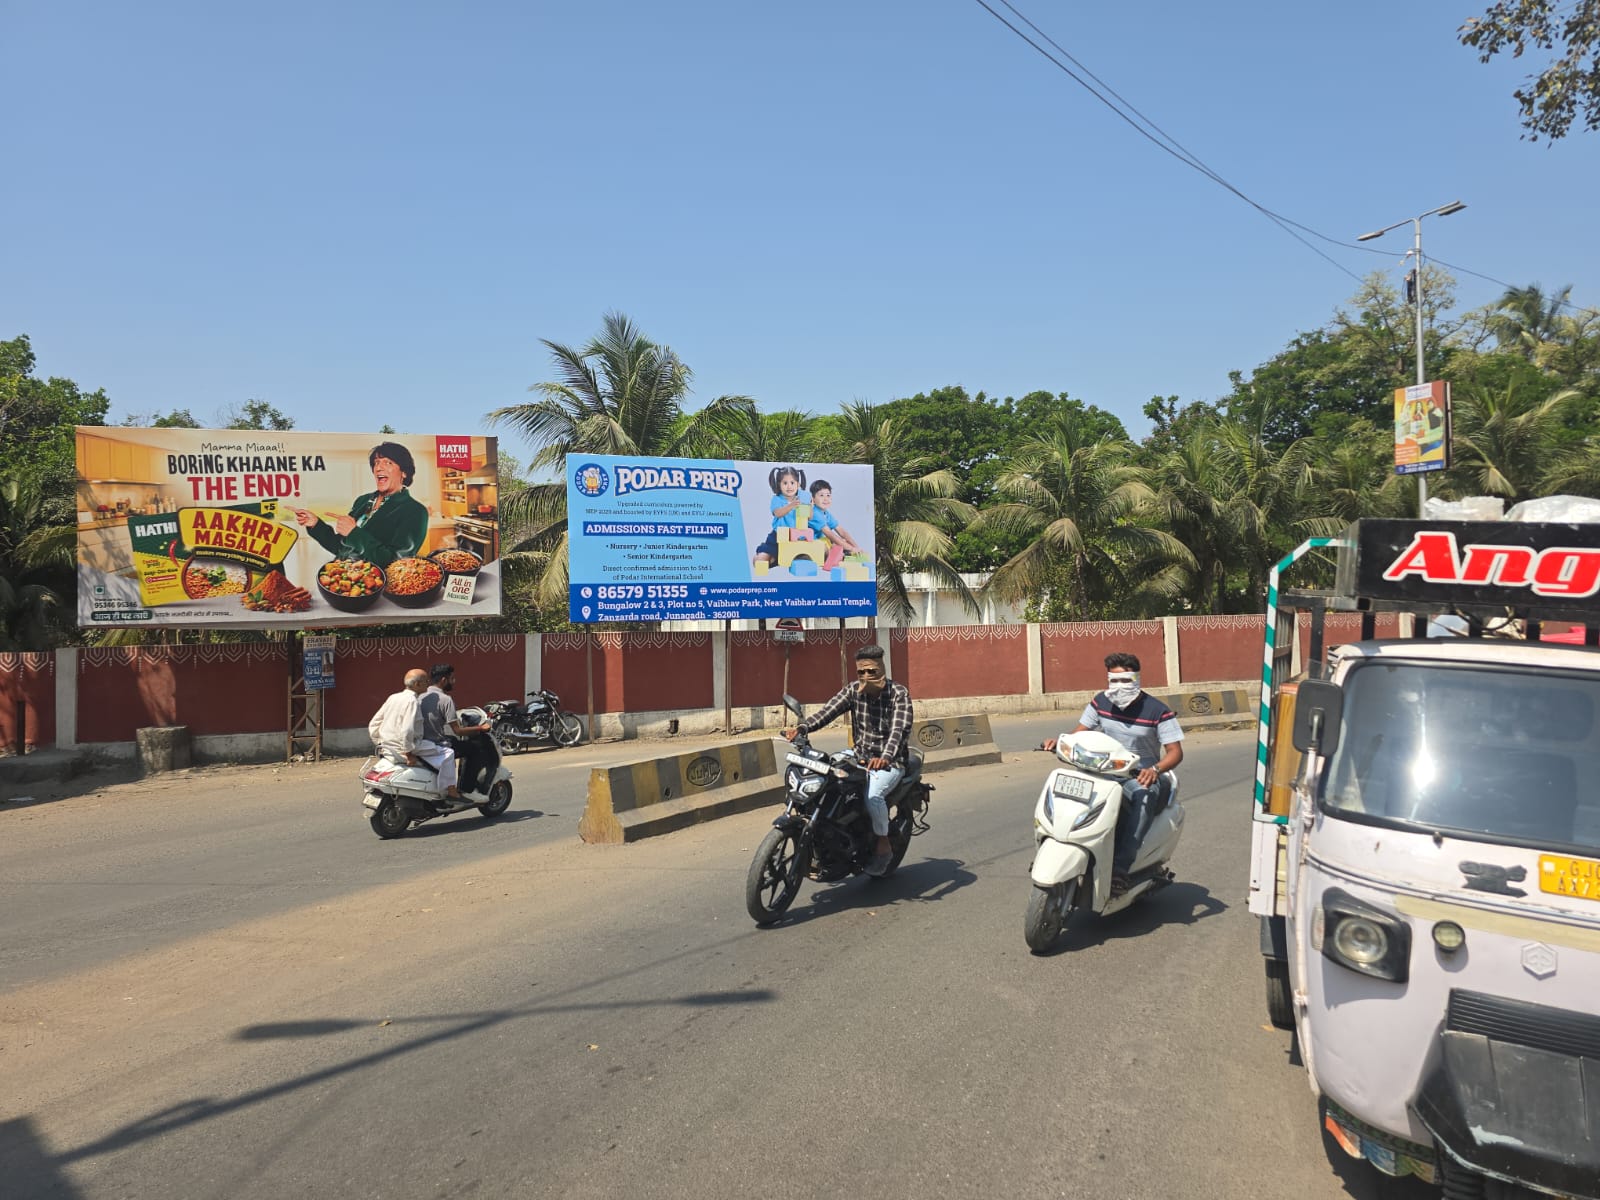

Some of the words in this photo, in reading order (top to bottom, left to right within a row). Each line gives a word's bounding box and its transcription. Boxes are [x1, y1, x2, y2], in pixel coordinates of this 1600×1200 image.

[201, 443, 242, 453] Mamma
[440, 444, 468, 453] HATHI
[227, 456, 297, 472] KHAANE
[302, 455, 326, 471] KA
[187, 476, 238, 501] THE
[244, 474, 300, 497] END!
[618, 468, 686, 494] PODAR
[689, 470, 740, 495] PREP
[135, 521, 177, 537] HATHI
[192, 510, 283, 544] AAKHRI
[586, 524, 656, 534] ADMISSIONS
[656, 524, 683, 534] FAST
[684, 525, 724, 535] FILLING
[194, 529, 272, 559] MASALA
[610, 543, 638, 551] Nursery
[451, 578, 462, 586] All
[464, 579, 472, 587] in
[452, 586, 470, 594] one
[598, 586, 644, 599] 86579
[648, 585, 688, 598] 51355
[710, 586, 778, 595] www.podarprep.com
[598, 601, 641, 611] Bungalow
[644, 601, 649, 609] 2
[650, 600, 657, 608] &
[658, 600, 666, 610] 3,
[667, 600, 684, 608] Plot
[698, 600, 705, 609] 5,
[707, 599, 740, 608] Vaibhav
[742, 599, 763, 608] Park,
[764, 599, 783, 607] Near
[784, 598, 816, 607] Vaibhav
[818, 598, 842, 606] Laxmi
[843, 597, 872, 607] Temple,
[598, 613, 639, 621] Zanzarda
[641, 612, 662, 621] road,
[664, 612, 706, 621] Junagadh
[712, 611, 740, 619] 362001
